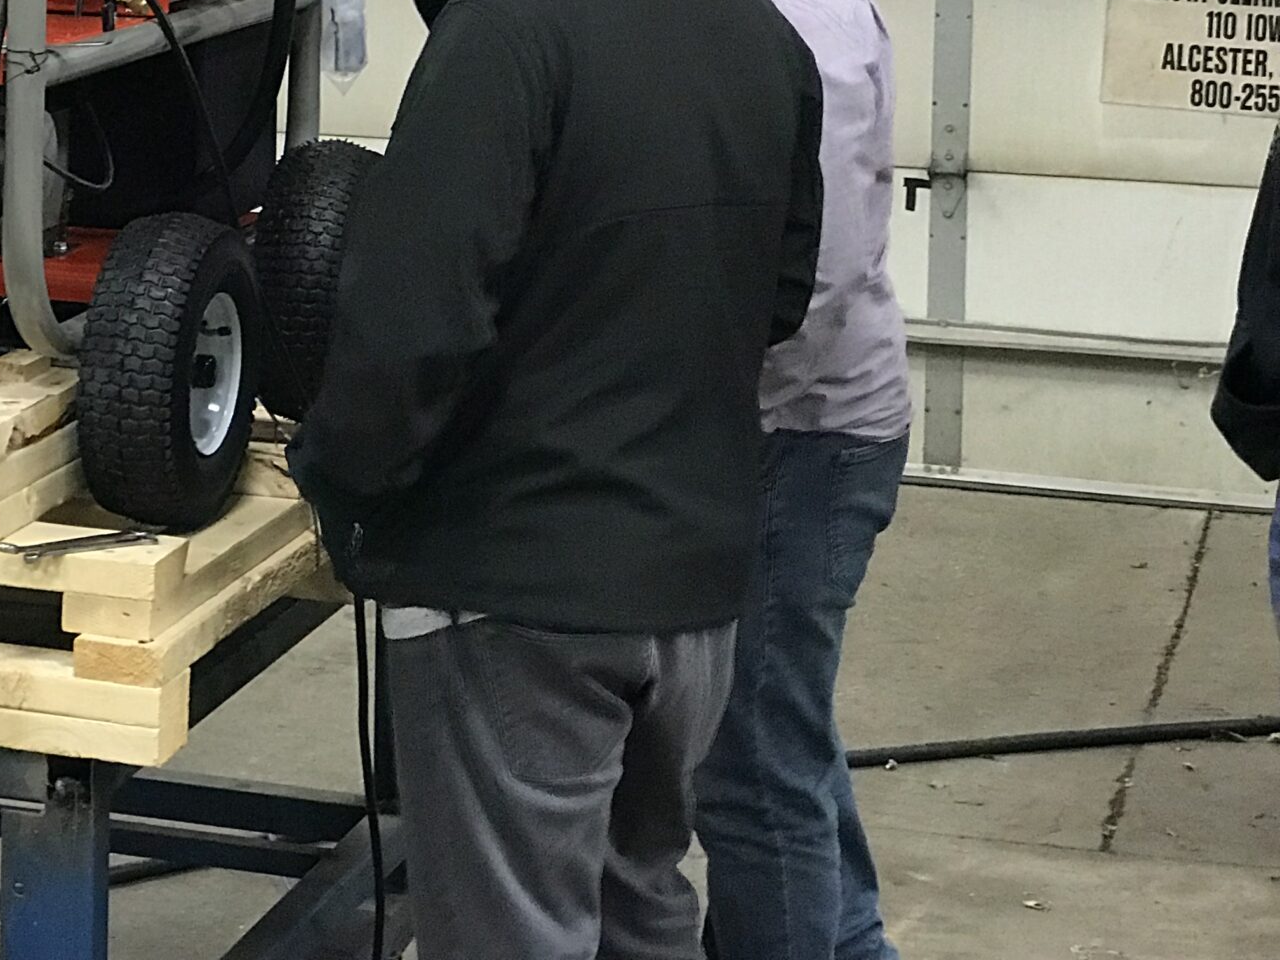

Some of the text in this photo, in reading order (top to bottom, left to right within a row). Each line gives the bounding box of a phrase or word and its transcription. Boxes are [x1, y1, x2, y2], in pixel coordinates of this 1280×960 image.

[1206, 11, 1237, 40] 110
[1161, 43, 1274, 80] ALCESTER,
[1190, 79, 1280, 113] 800-255
